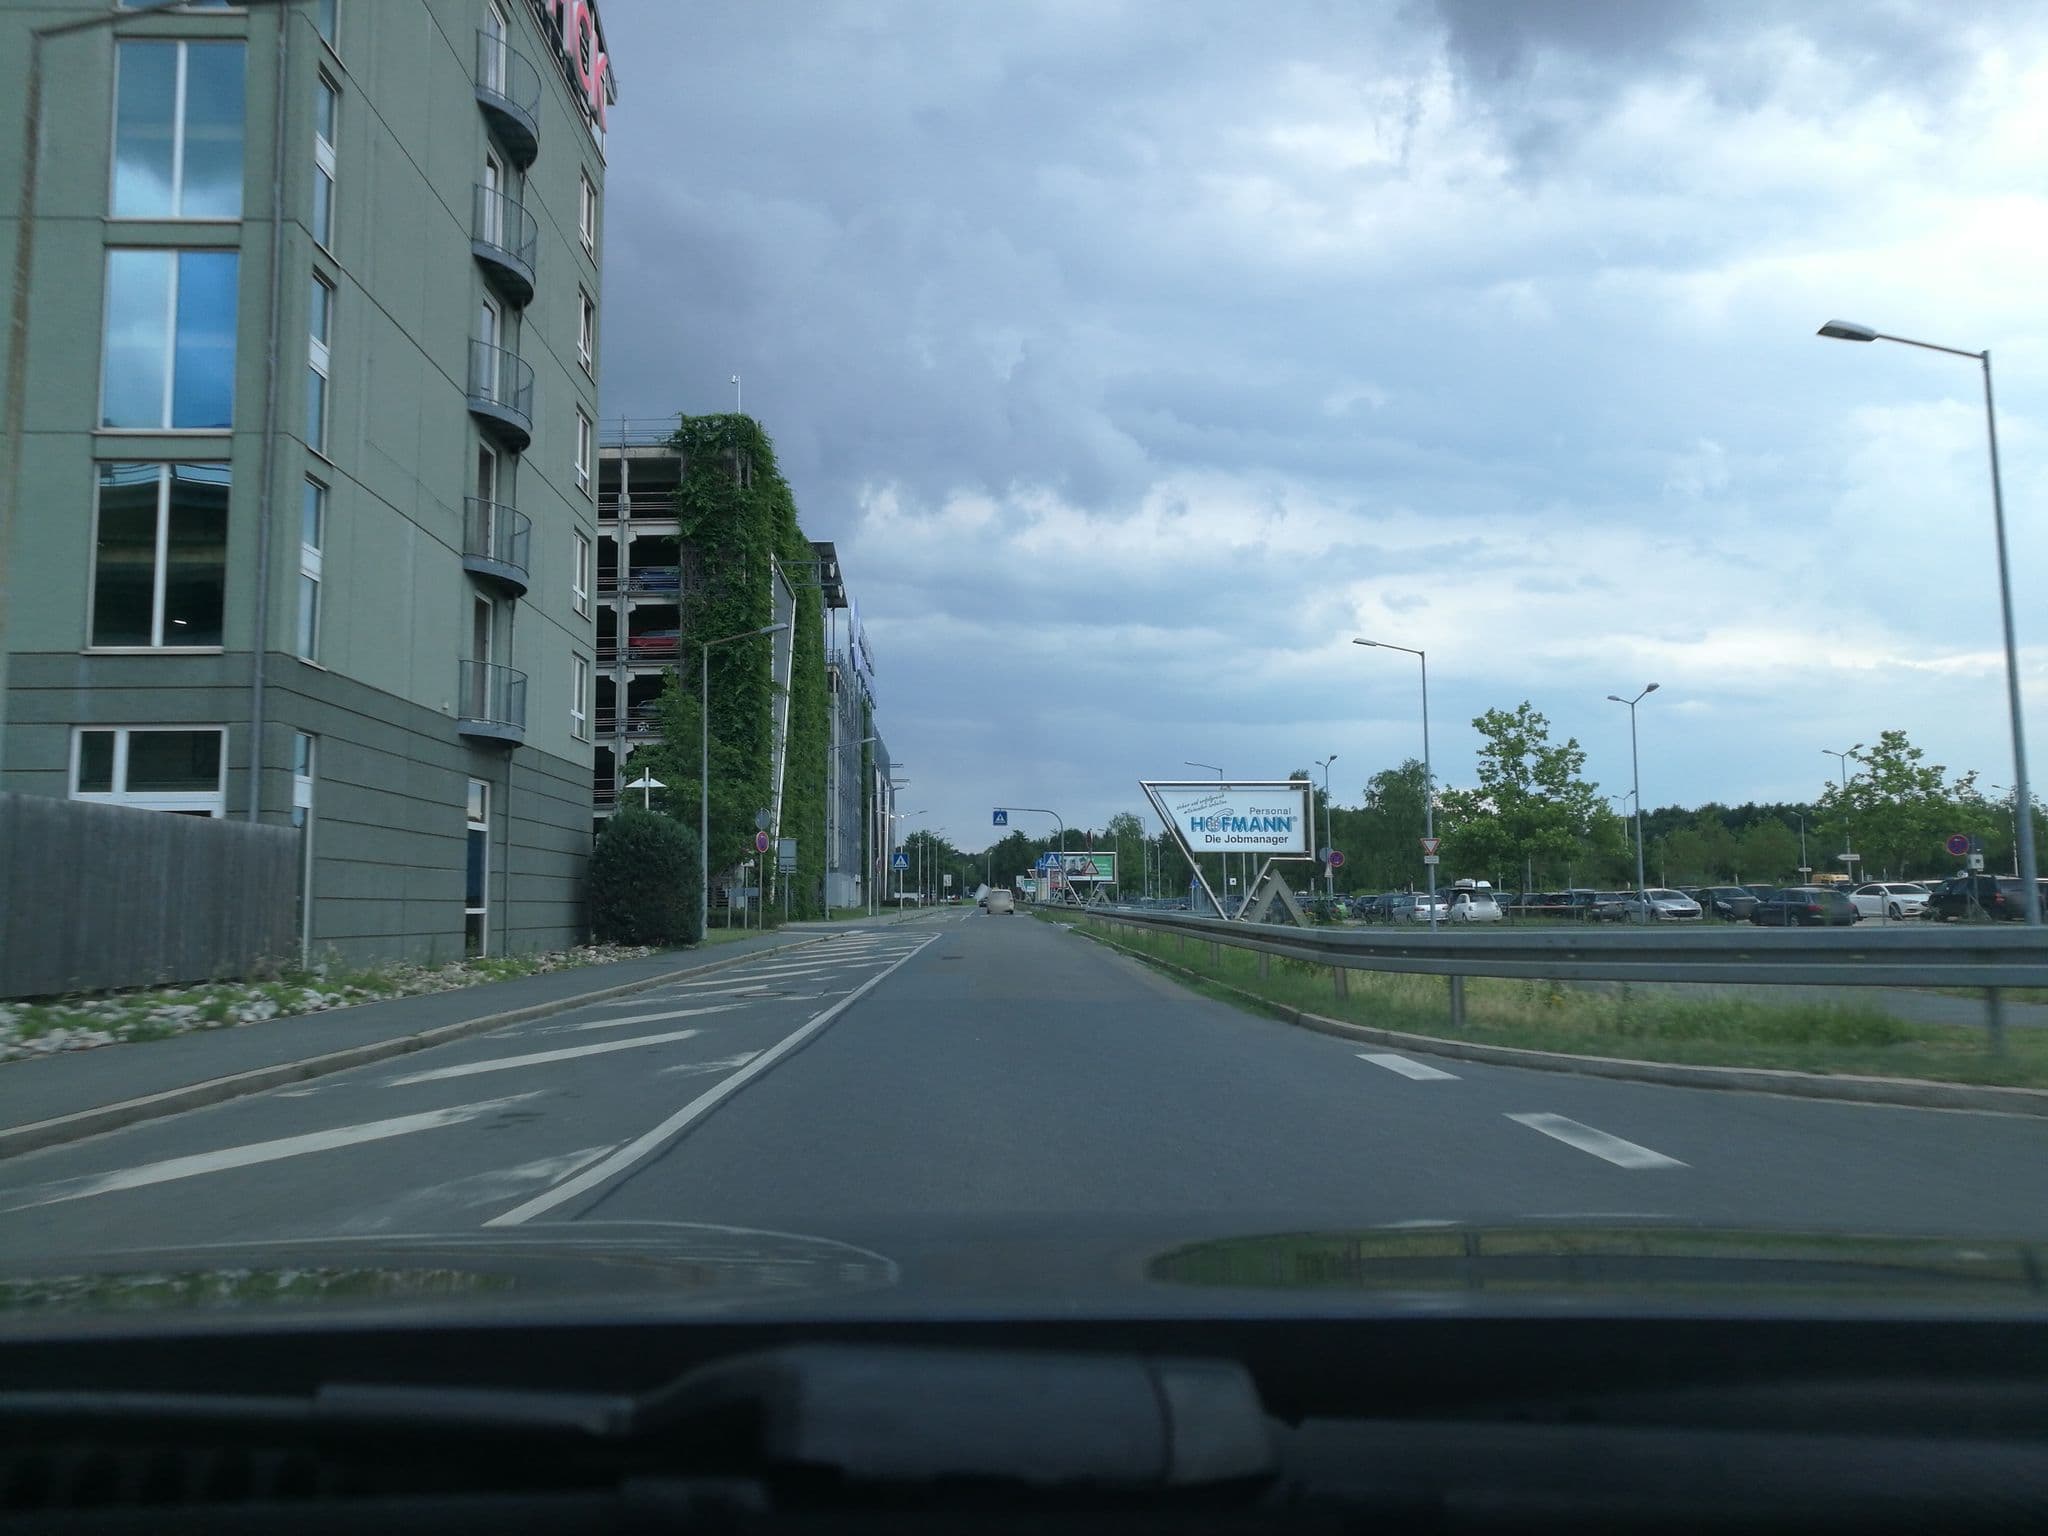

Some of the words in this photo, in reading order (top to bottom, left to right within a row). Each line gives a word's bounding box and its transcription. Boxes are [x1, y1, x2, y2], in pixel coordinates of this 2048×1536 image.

[1249, 807, 1292, 815] Personal
[1190, 816, 1293, 833] HOFMANN
[1205, 834, 1222, 844] Die
[1224, 834, 1289, 846] Jobmanager
